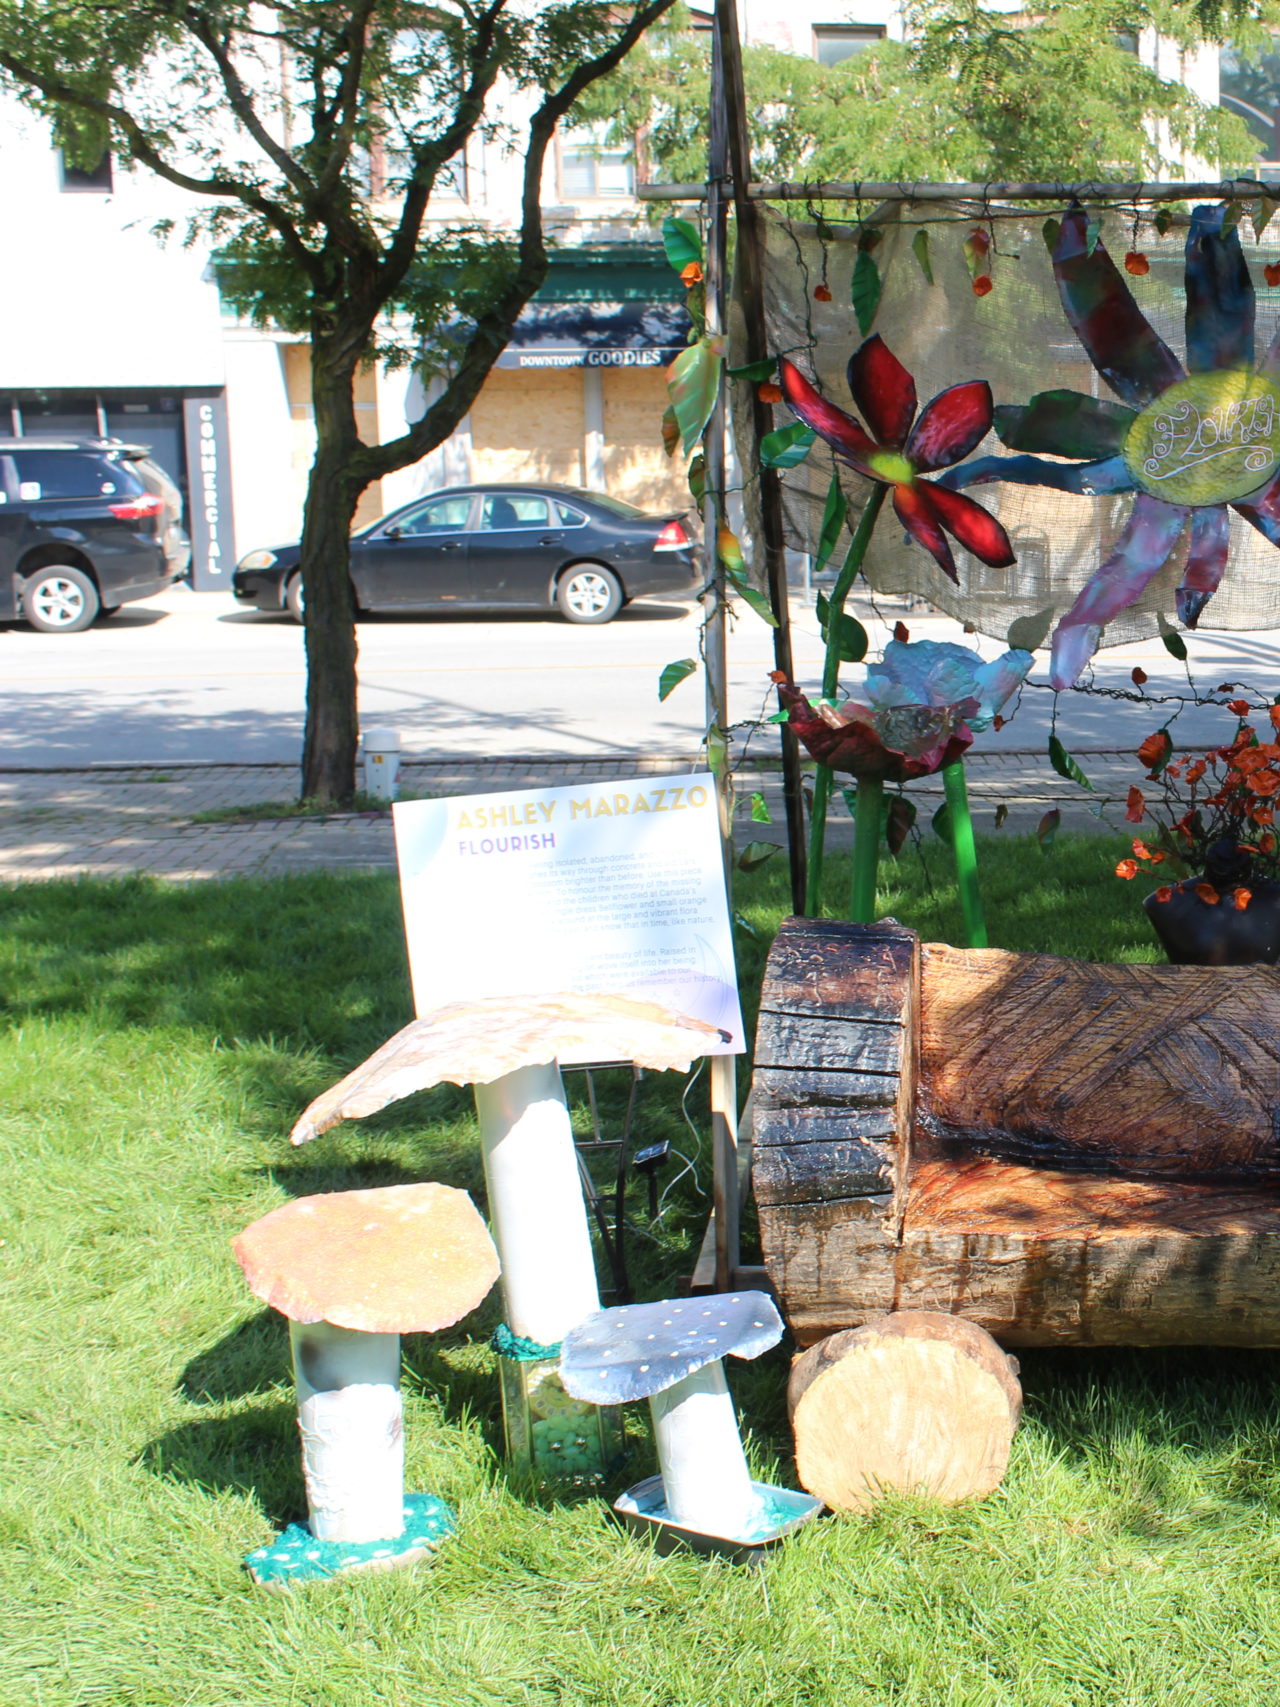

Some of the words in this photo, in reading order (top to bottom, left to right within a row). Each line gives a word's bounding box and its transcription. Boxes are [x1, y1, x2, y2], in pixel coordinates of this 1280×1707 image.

[520, 355, 584, 367] DOWNTOWN
[588, 350, 662, 366] GOODIES
[199, 404, 222, 575] COMMERCIAL
[456, 799, 557, 831] ASHLEY
[569, 784, 709, 821] MARAZZO
[458, 832, 557, 856] FLOURISH
[577, 894, 609, 904] children
